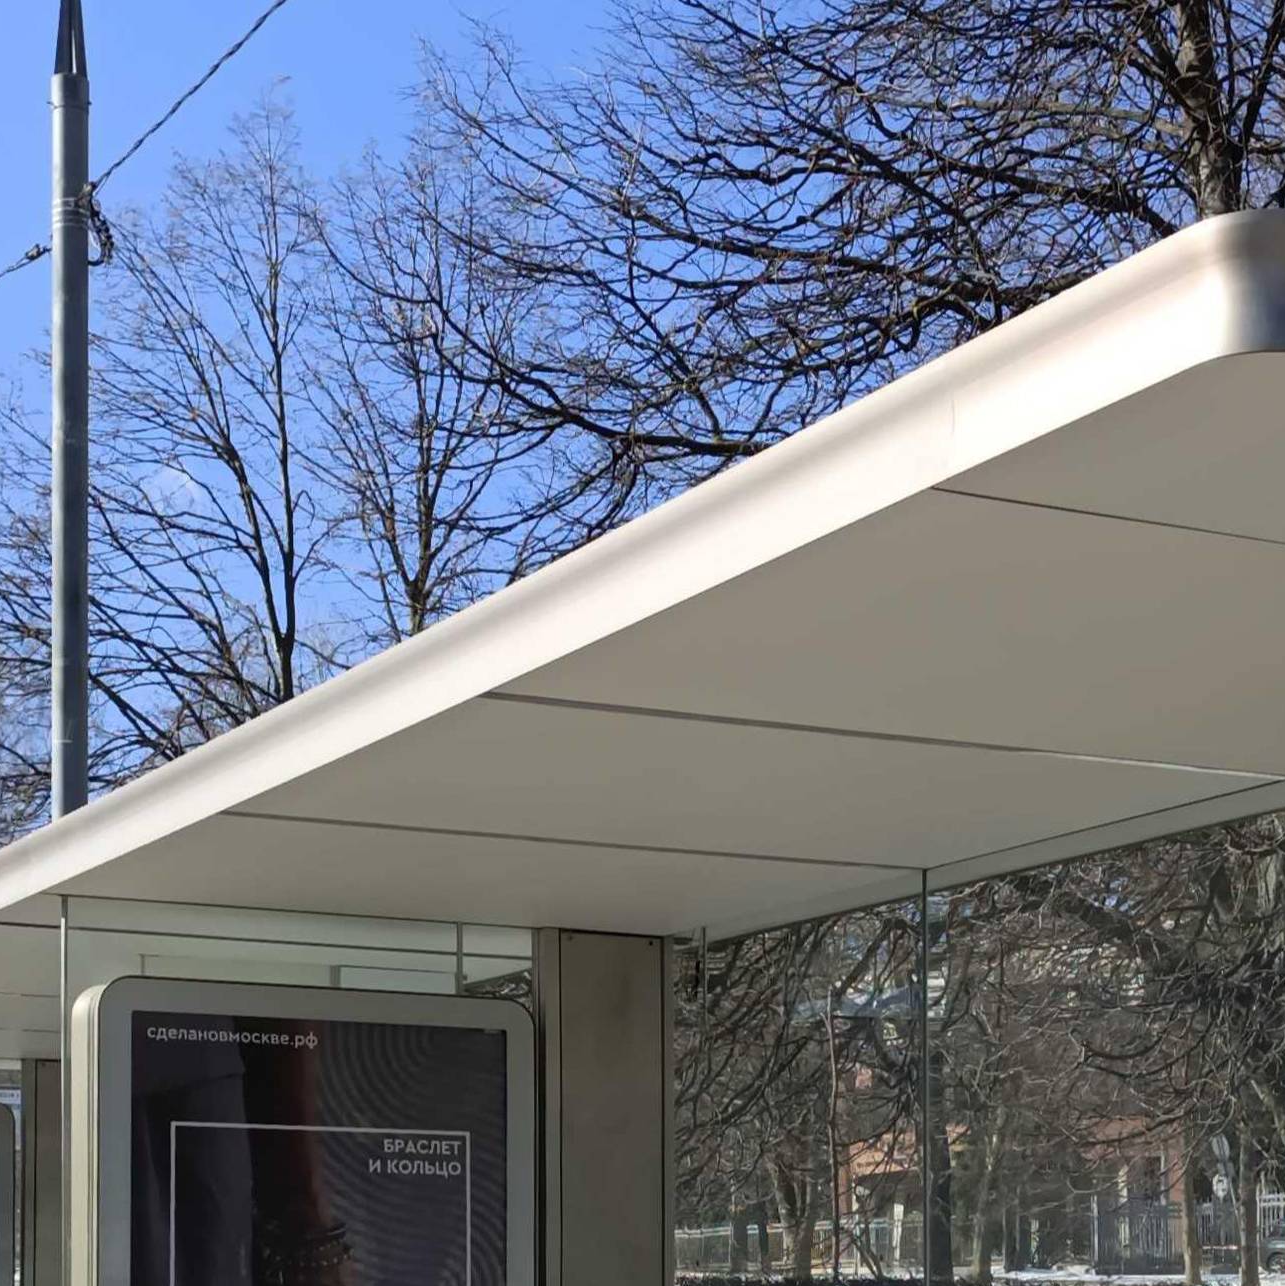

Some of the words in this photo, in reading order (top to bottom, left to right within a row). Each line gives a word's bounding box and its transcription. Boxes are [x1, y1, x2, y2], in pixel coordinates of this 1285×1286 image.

[146, 1026, 319, 1049] сделановмоскве.рф
[383, 1138, 463, 1155] БРАСЛЕТ
[368, 1158, 382, 1174] И
[387, 1159, 462, 1179] КОЛЬЦО
